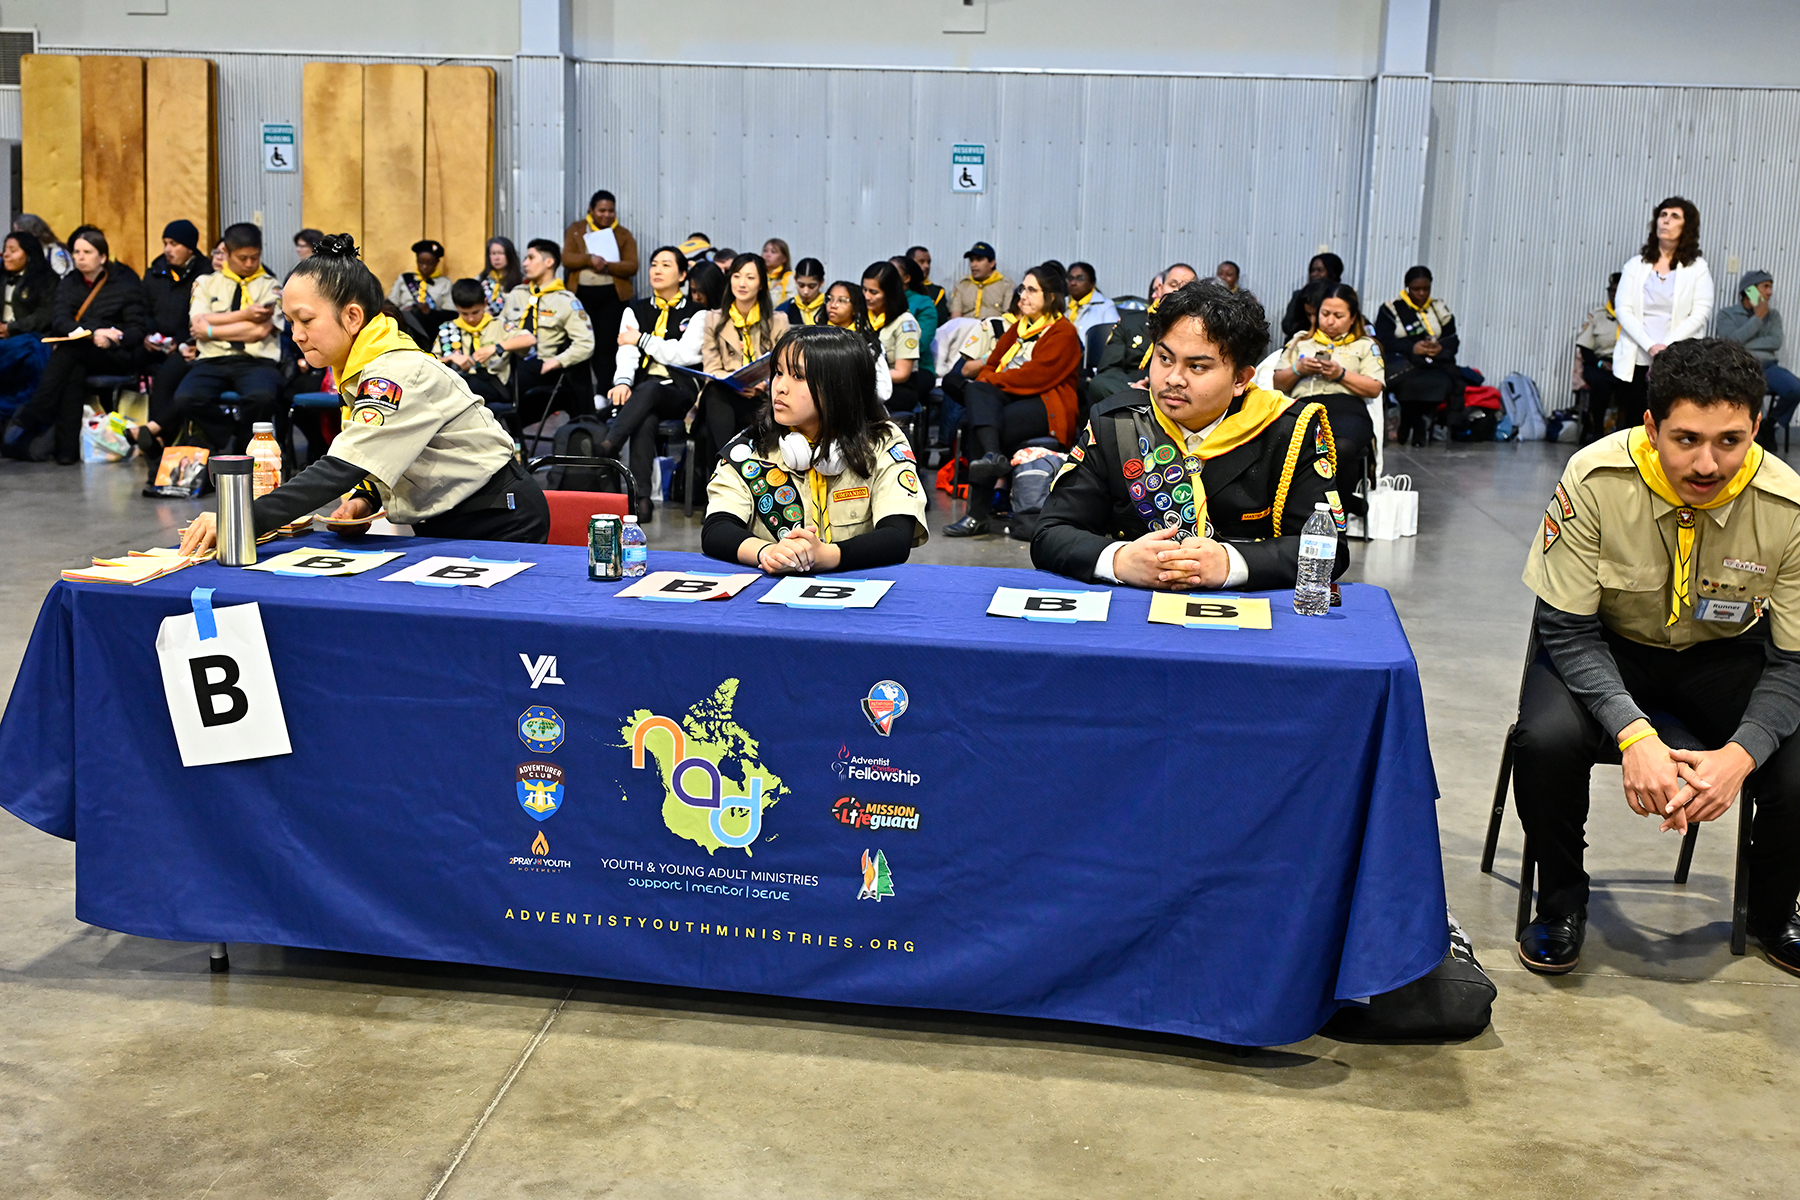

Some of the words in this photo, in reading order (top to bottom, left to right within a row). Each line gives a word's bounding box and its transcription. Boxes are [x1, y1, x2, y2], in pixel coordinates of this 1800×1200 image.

[293, 556, 355, 569] B
[1735, 563, 1766, 573] CAPTAIN
[427, 565, 489, 579] B
[660, 579, 718, 593] B
[800, 585, 856, 599] B
[1024, 597, 1077, 611] B
[1186, 603, 1239, 618] B
[1713, 603, 1741, 611] Runner
[189, 655, 249, 728] B
[851, 756, 890, 767] Adventist
[519, 764, 562, 777] ADVENTURER
[848, 766, 921, 787] Fellowship
[866, 803, 915, 818] MISSION
[601, 858, 643, 872] YOUTH
[647, 862, 656, 873] &
[659, 863, 705, 878] YOUNG
[708, 867, 748, 880] ADULT
[751, 871, 819, 886] MINISTRIES
[691, 883, 744, 897] mentor
[505, 908, 915, 953] ADVENTISTYOUTHMINISTRIES.ORG
